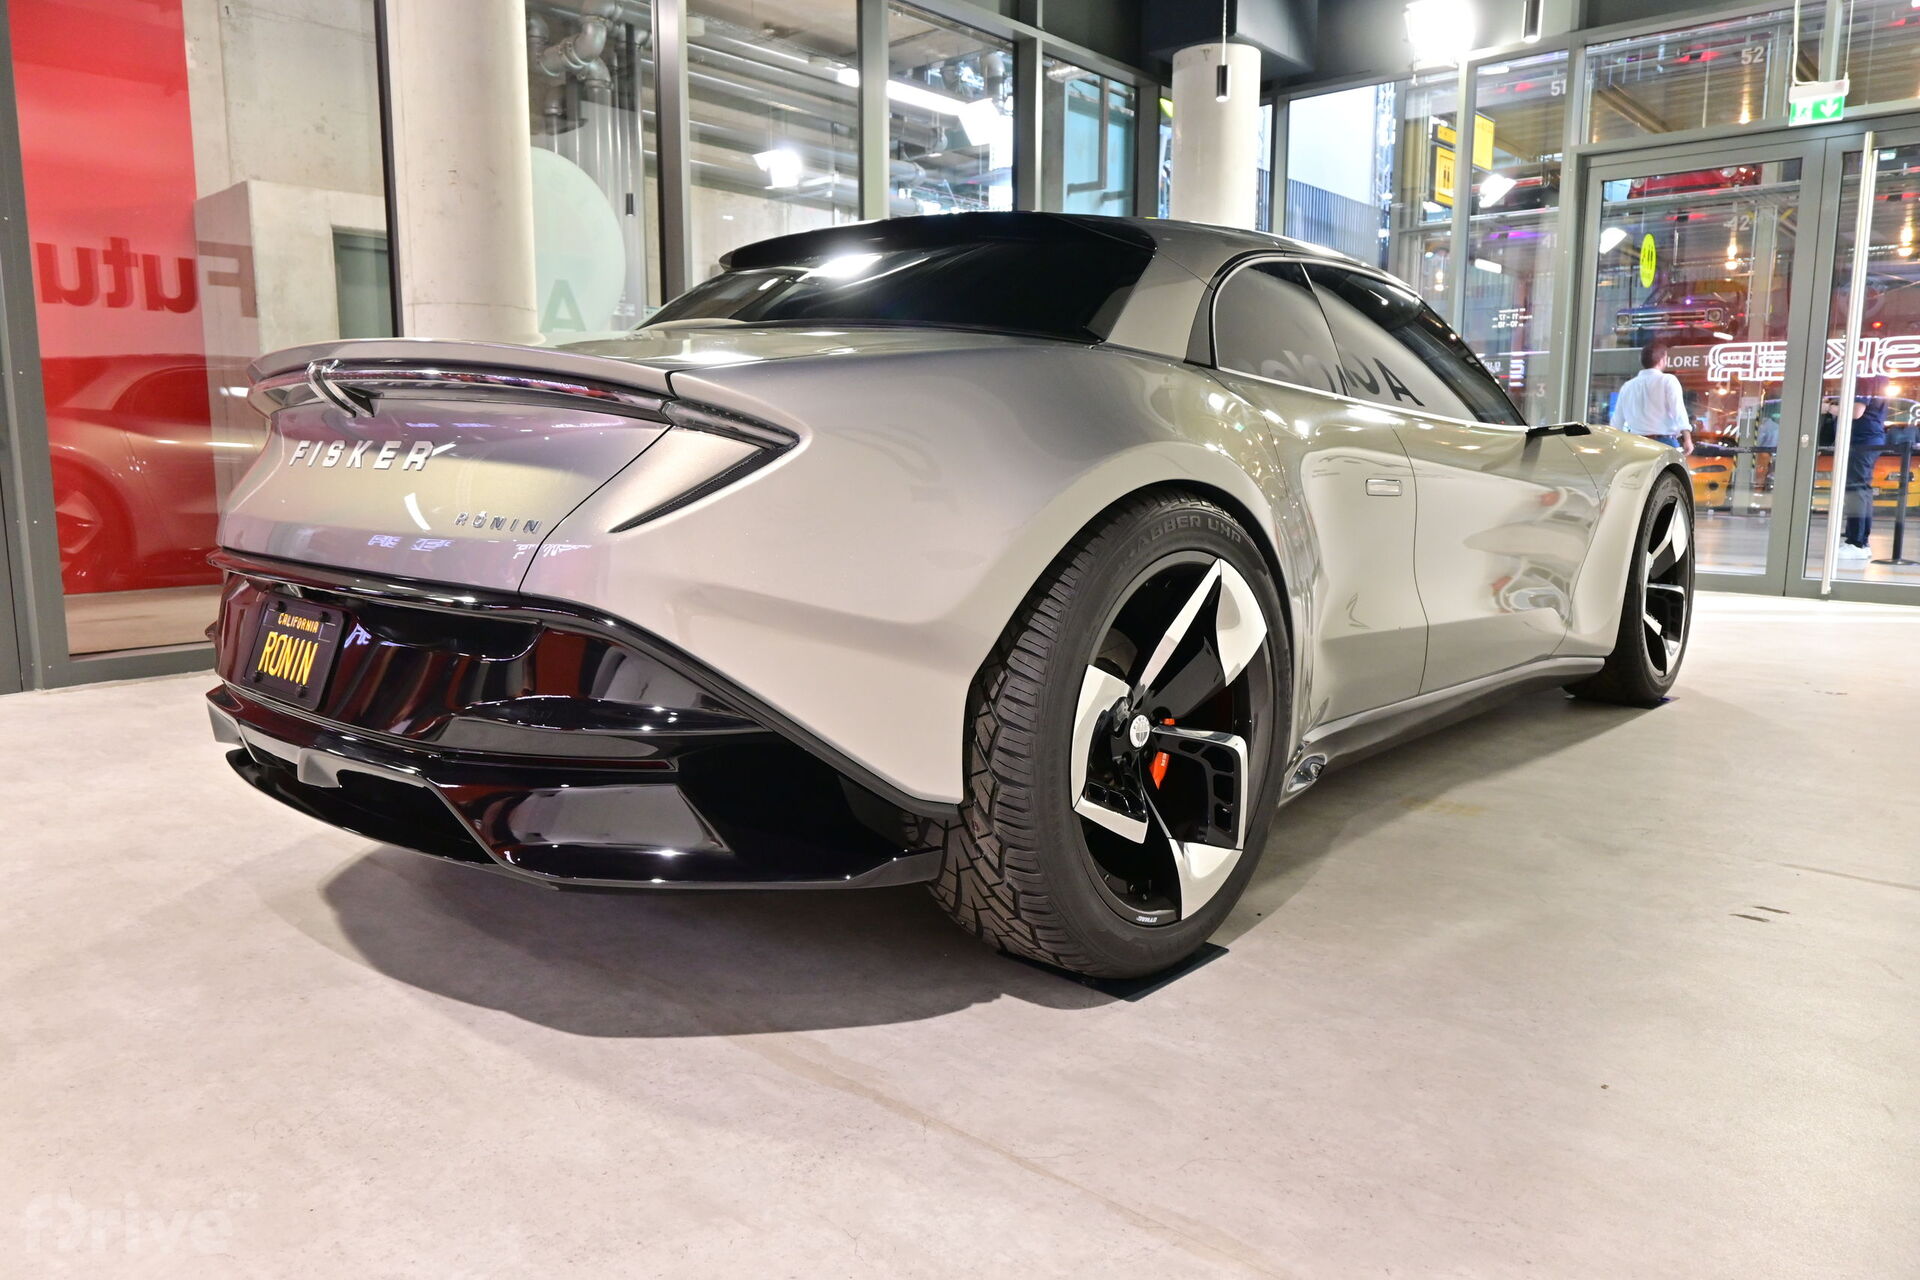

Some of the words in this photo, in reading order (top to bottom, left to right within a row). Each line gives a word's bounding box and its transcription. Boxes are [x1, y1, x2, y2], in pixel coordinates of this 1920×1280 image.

[1740, 46, 1764, 66] 52
[288, 439, 435, 471] FISKER
[277, 612, 320, 634] CALIFORNIA
[257, 631, 319, 686] RONIN
